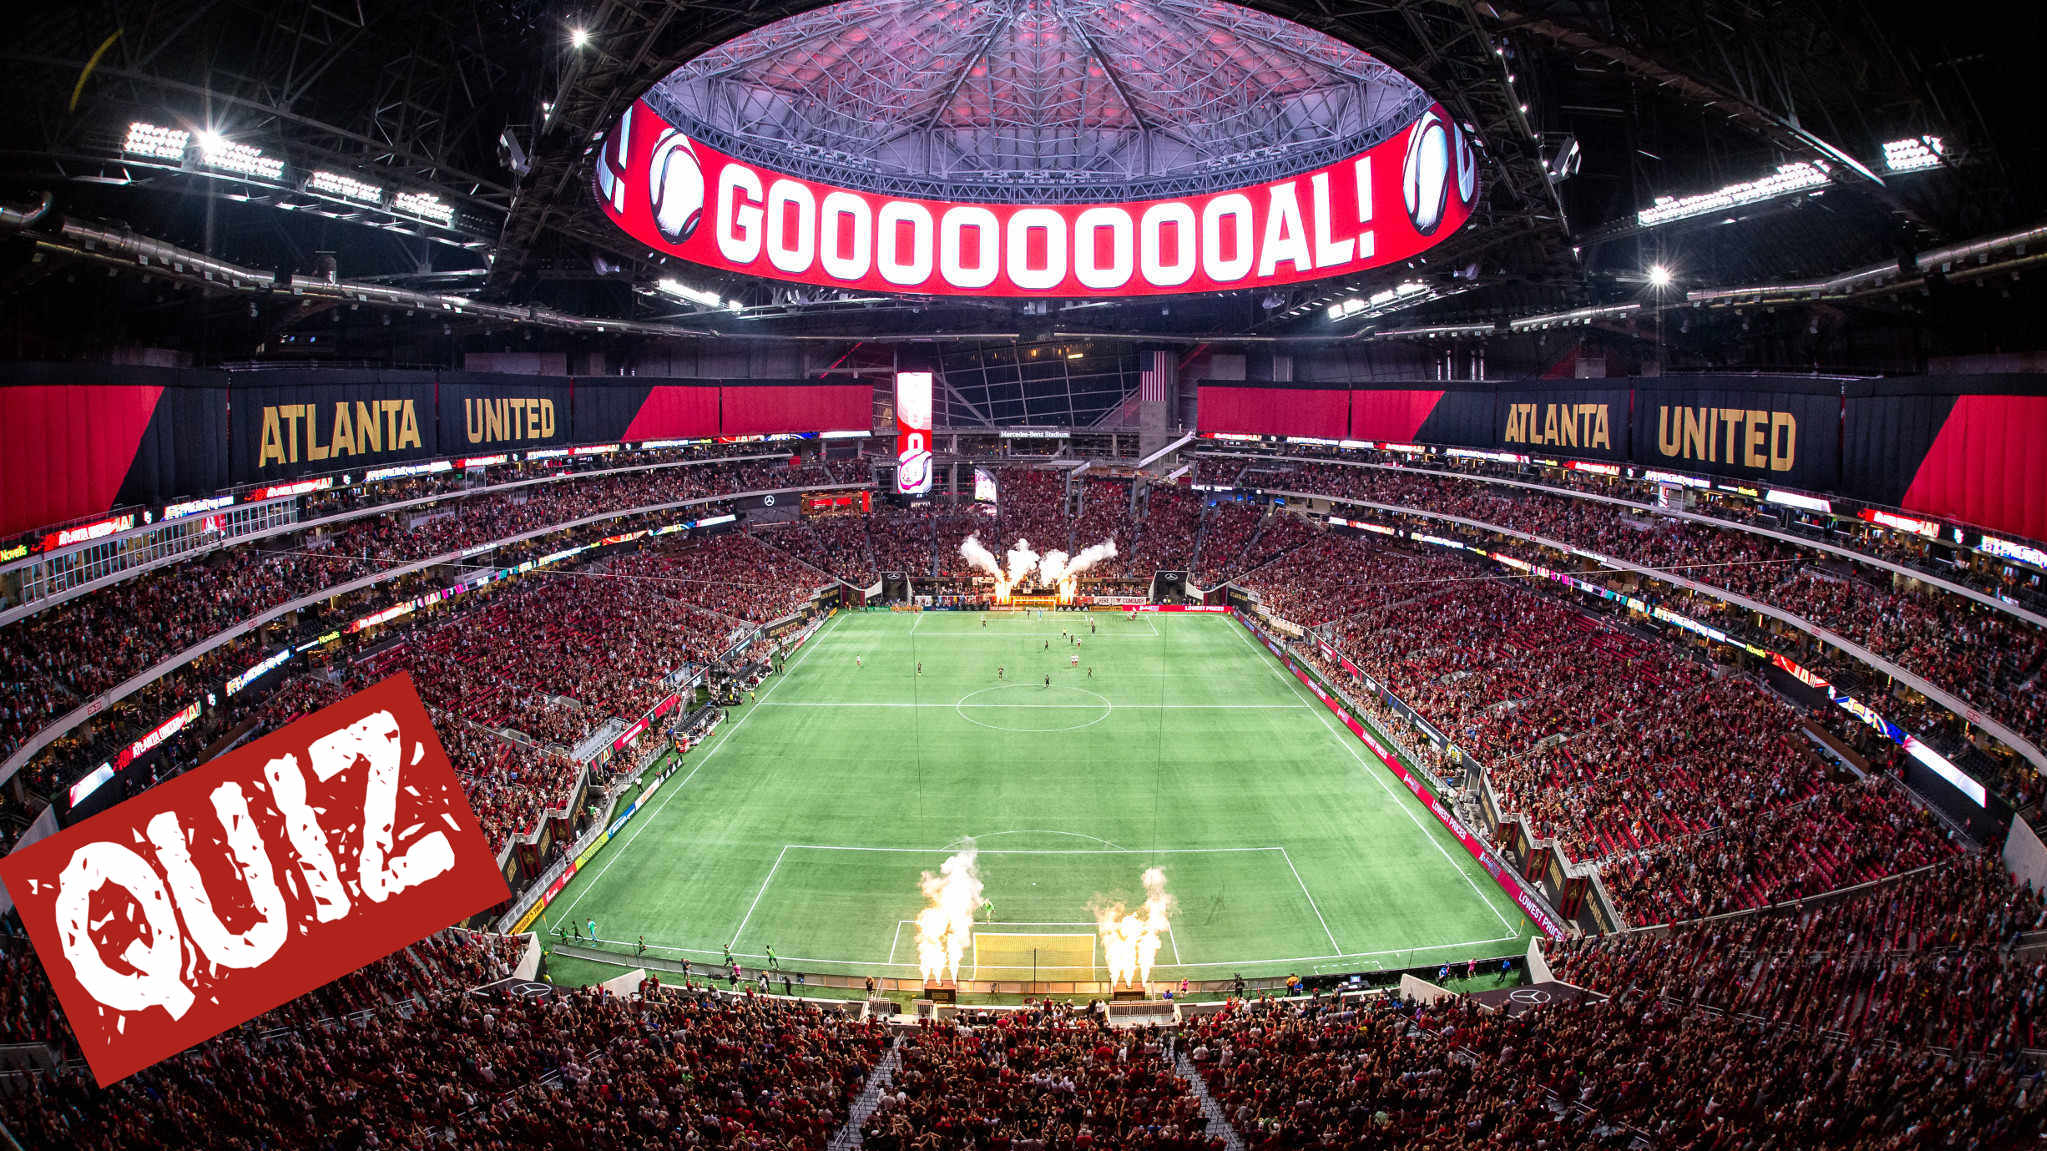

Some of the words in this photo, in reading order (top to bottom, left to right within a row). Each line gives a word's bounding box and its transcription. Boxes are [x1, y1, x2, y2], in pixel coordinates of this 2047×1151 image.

[716, 156, 1376, 289] GOOOOOOOOAL!
[259, 399, 421, 467] ATLANTA
[464, 397, 555, 443] UNITED
[1505, 403, 1611, 450] ATLANTA
[1659, 405, 1796, 472] UNITED
[1518, 891, 1545, 923] LOWEST
